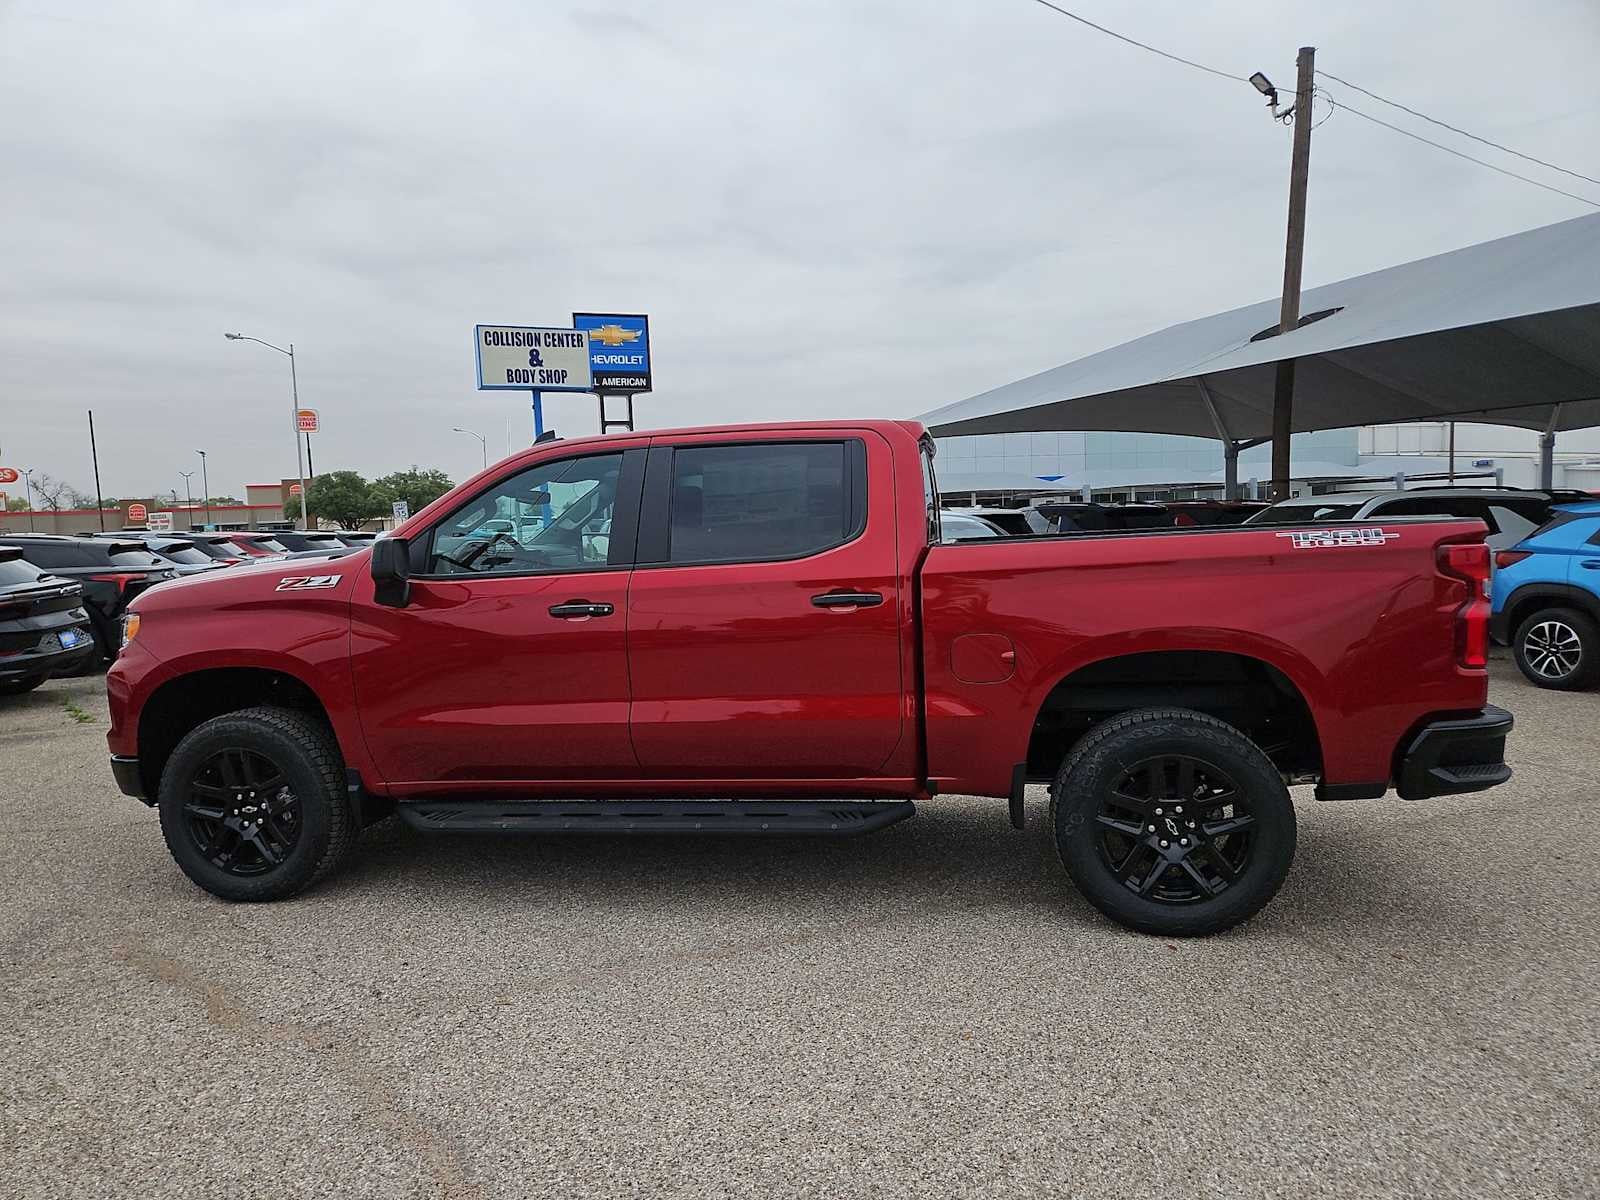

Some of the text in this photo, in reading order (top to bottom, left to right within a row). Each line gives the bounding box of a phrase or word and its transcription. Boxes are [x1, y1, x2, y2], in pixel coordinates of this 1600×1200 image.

[484, 331, 584, 348] COLLISION CENTER
[529, 348, 543, 367] &
[591, 355, 644, 365] HEVROLET
[506, 368, 568, 385] BODY SHOP
[601, 377, 647, 387] AMERICAN
[1277, 529, 1399, 541] TRAIL
